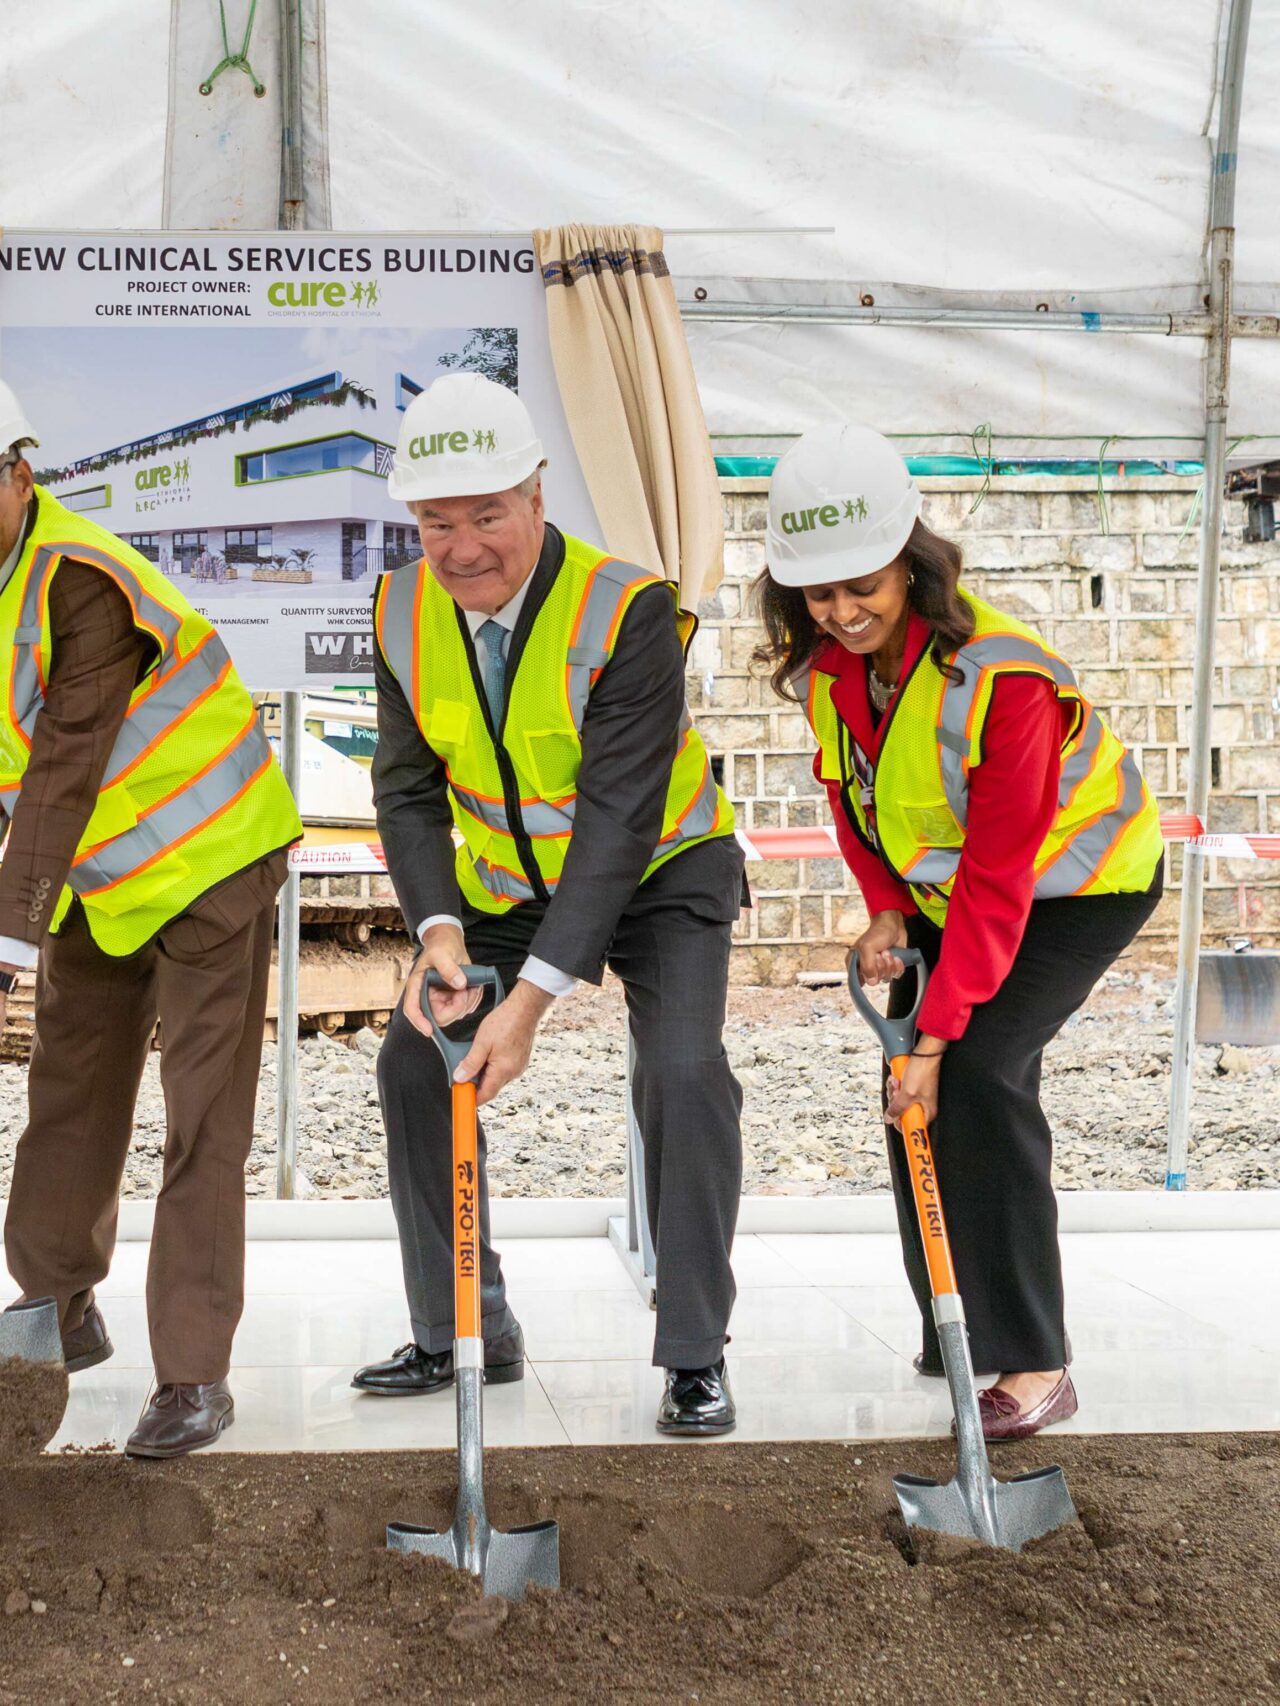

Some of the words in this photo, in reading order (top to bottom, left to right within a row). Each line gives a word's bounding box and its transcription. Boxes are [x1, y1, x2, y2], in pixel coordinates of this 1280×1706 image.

[77, 247, 217, 271] CLINICAL
[227, 247, 371, 272] SERVICES
[384, 249, 534, 273] BUILDING
[127, 281, 187, 293] PROJECT
[191, 281, 251, 293] OWNER:
[267, 281, 347, 307] cure
[95, 304, 132, 317] CURE
[137, 304, 252, 317] INTERNATIONAL
[408, 430, 469, 460] cure
[135, 465, 172, 491] cure
[781, 504, 840, 535] cure
[280, 607, 325, 616] QUANTITY
[290, 850, 351, 864] CAUTION
